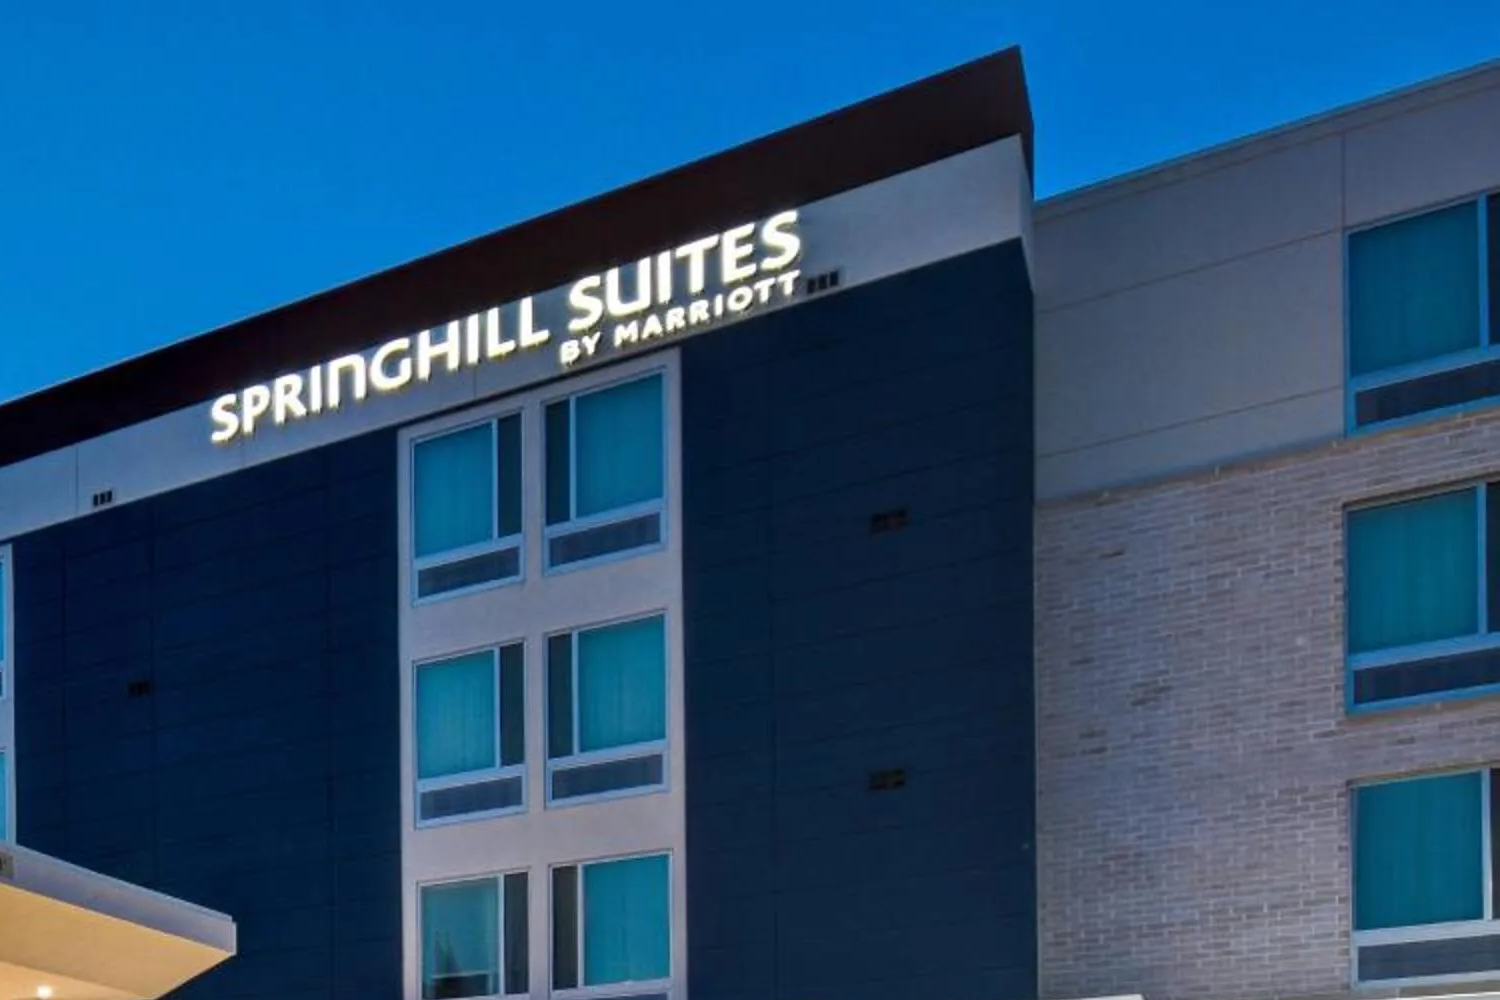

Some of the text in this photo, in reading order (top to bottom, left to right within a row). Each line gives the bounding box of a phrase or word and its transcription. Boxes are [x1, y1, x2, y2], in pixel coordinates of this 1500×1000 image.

[209, 209, 802, 443] SPRINGHILL SUITES
[558, 269, 801, 366] BY MARRIOTT
